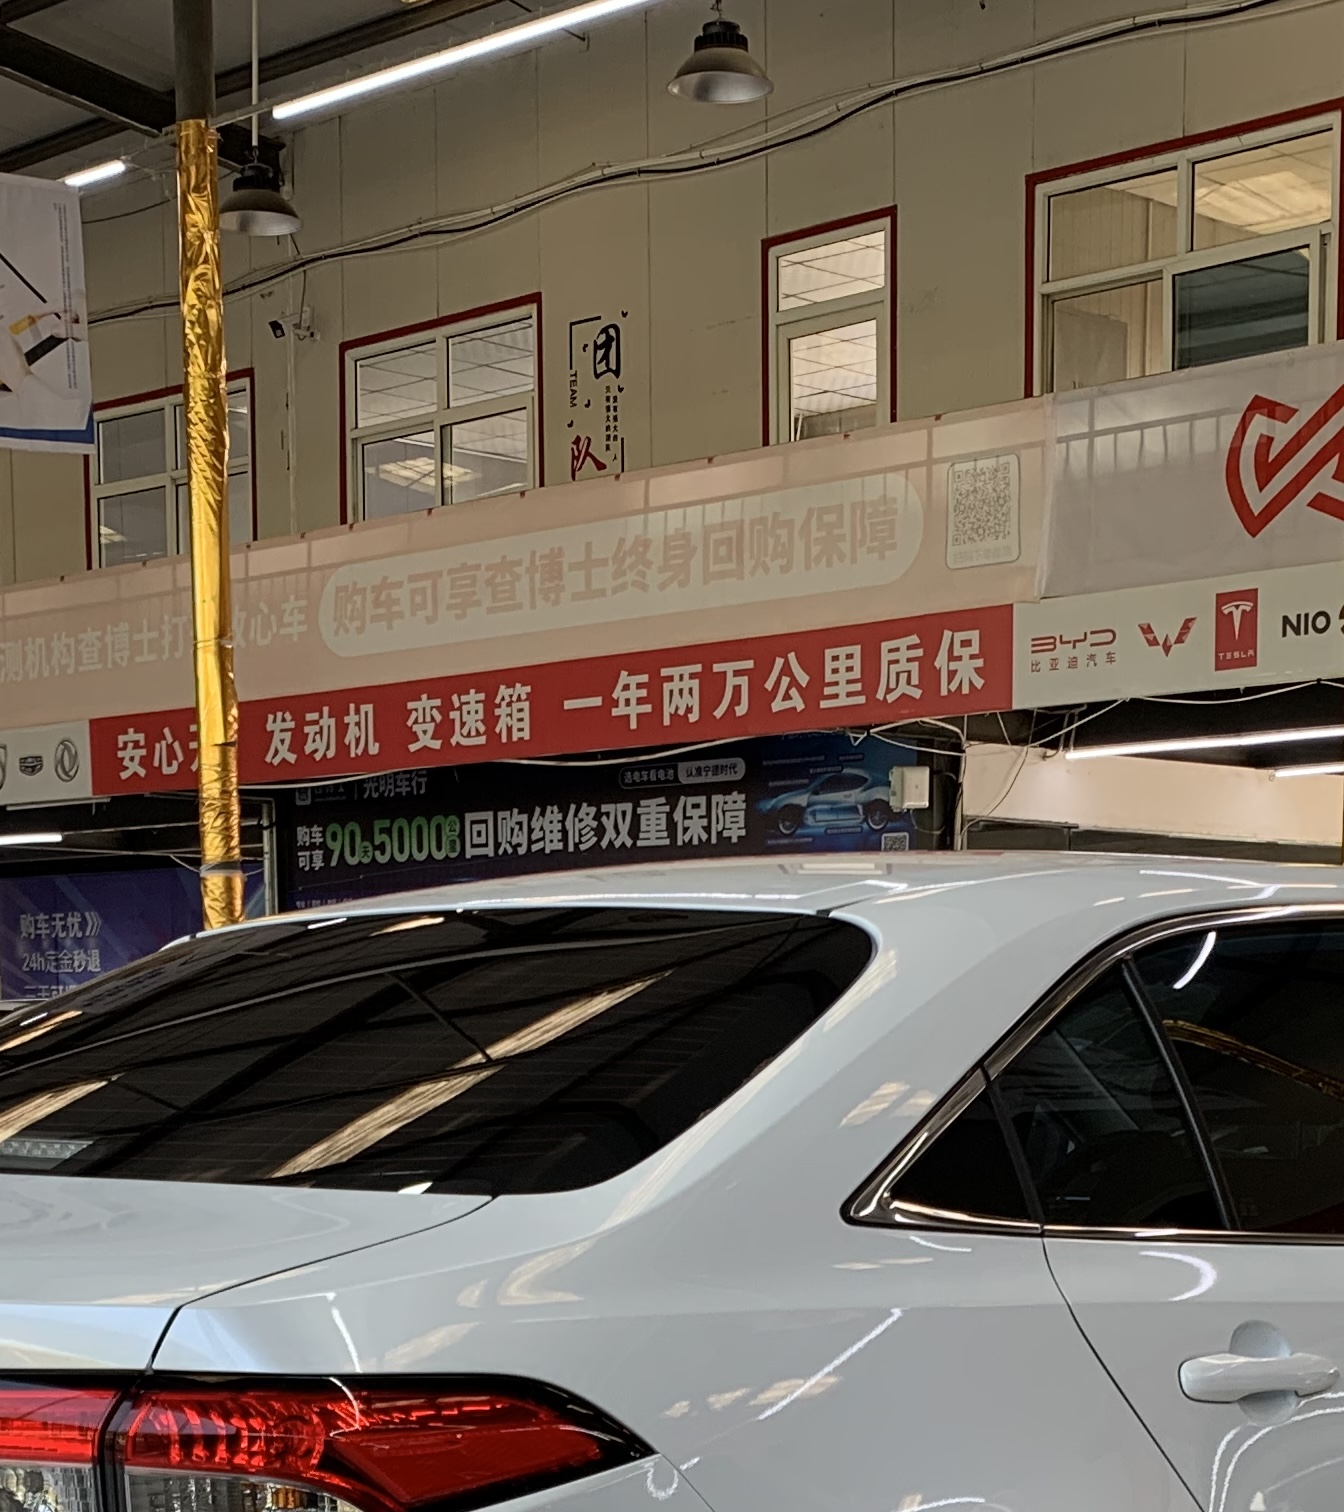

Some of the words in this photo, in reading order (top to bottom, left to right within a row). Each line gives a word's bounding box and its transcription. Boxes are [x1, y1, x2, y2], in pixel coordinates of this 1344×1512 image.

[593, 323, 621, 380] 团
[569, 370, 578, 408] TEAM
[333, 495, 898, 638] 购车可享查博士终身回购保障
[1281, 610, 1331, 638] NIO
[1031, 628, 1117, 654] BYD
[1218, 649, 1255, 660] TESLA
[1031, 651, 1117, 673] 比亚迪汽车
[264, 703, 380, 767] 发动机
[406, 683, 532, 754] 变速箱
[564, 629, 985, 730] 一年两万公里质保
[363, 770, 428, 799] 光明车行
[297, 824, 324, 847] 购车
[464, 791, 747, 859] 回购维修双重保障
[297, 849, 325, 871] 可享
[20, 911, 83, 939] 购车无忧
[22, 949, 102, 973] 24h定金秒退
